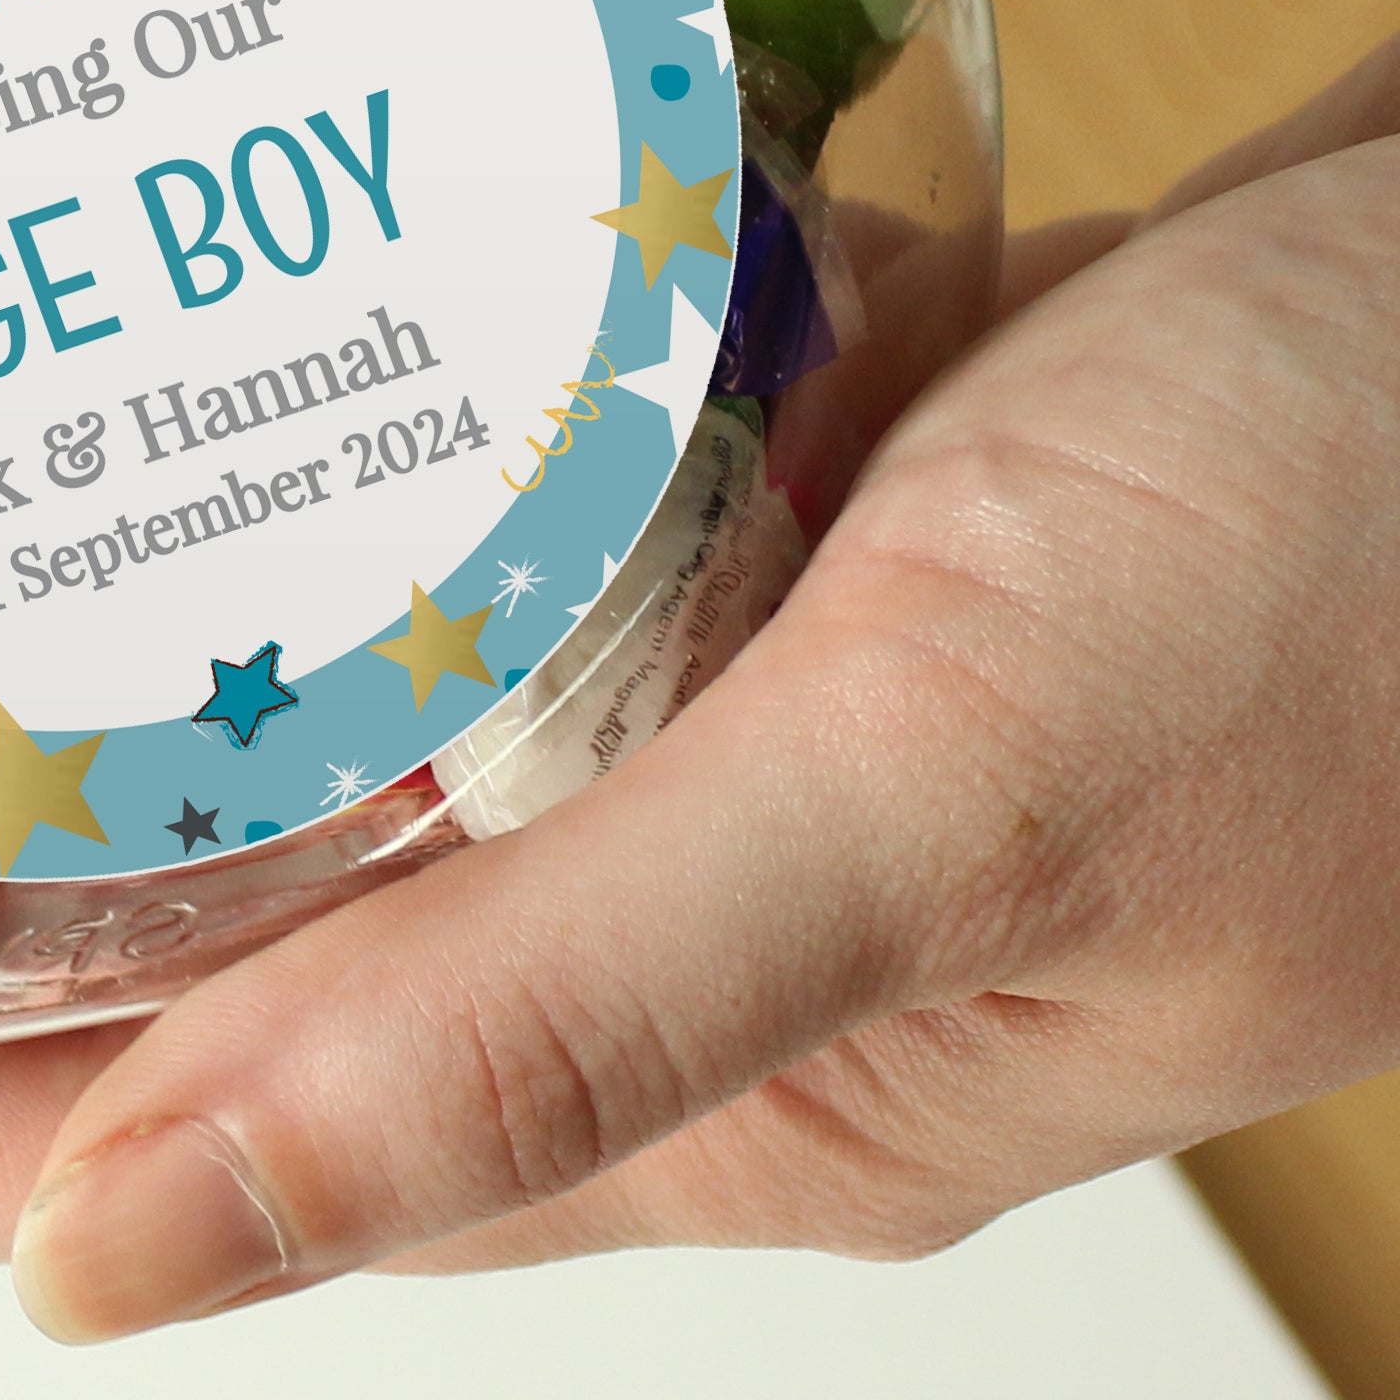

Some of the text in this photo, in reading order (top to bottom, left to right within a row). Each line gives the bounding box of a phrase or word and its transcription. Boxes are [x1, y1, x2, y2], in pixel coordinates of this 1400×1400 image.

[134, 89, 401, 309] BOY
[43, 412, 105, 488] &
[123, 306, 441, 464] Hannah
[10, 459, 331, 602] September
[342, 396, 490, 489] 2024
[649, 584, 690, 654] Agent
